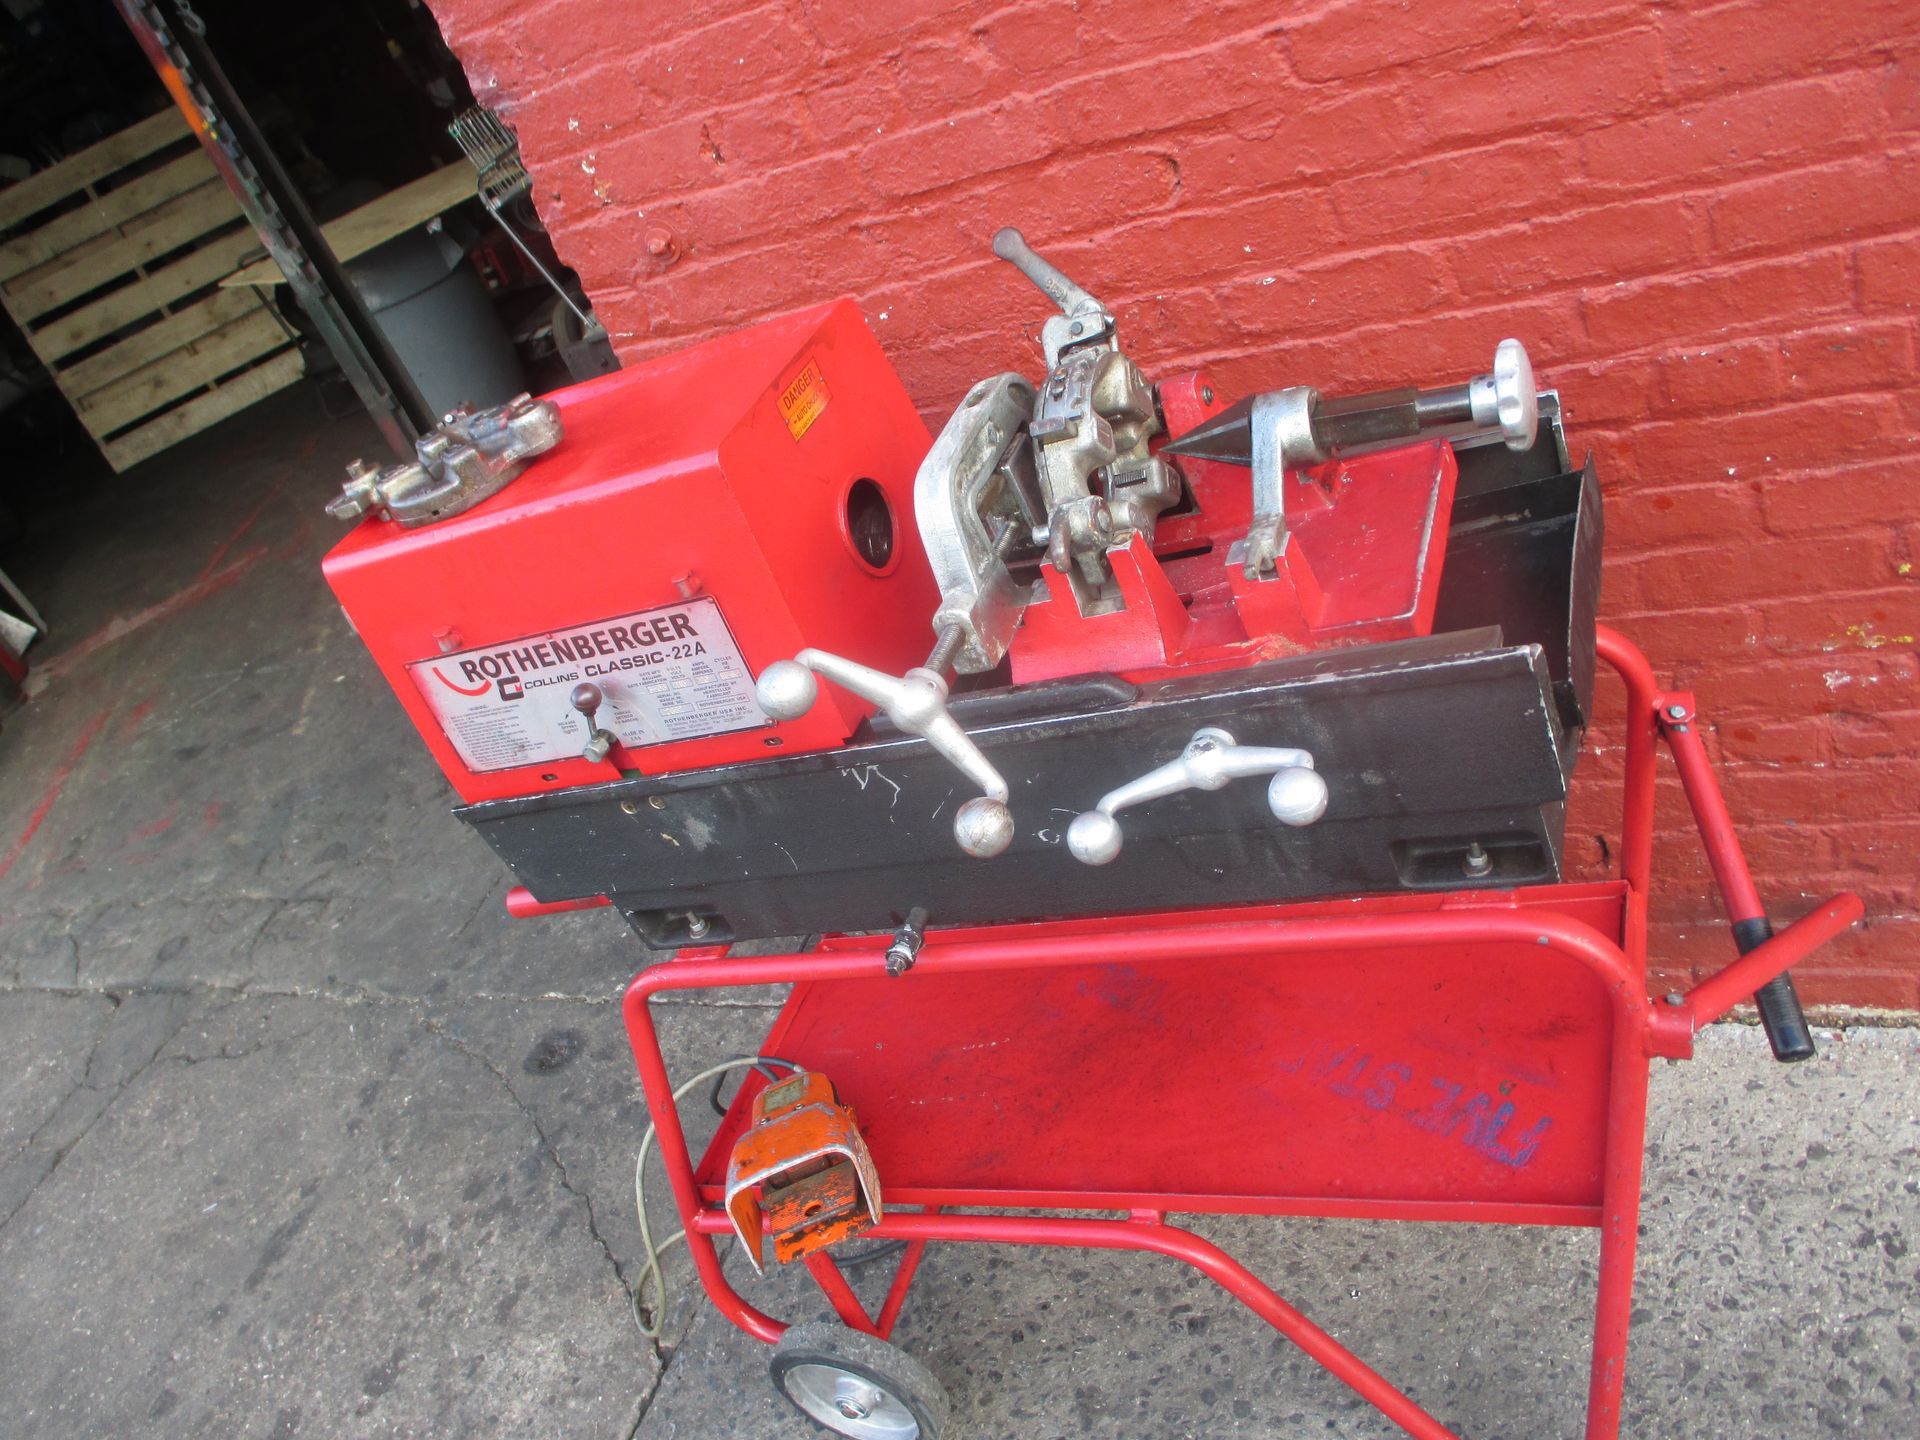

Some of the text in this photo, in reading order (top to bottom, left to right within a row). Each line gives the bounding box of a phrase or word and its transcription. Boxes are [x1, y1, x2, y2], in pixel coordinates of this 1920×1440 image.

[783, 368, 815, 410] DANGER
[459, 612, 698, 683] ROTHENBERGER
[524, 671, 580, 690] COLLINS
[585, 642, 707, 677] CLASSIC-22A
[664, 711, 717, 724] ROTHENBERGER
[699, 698, 735, 707] ROTHENBERGER
